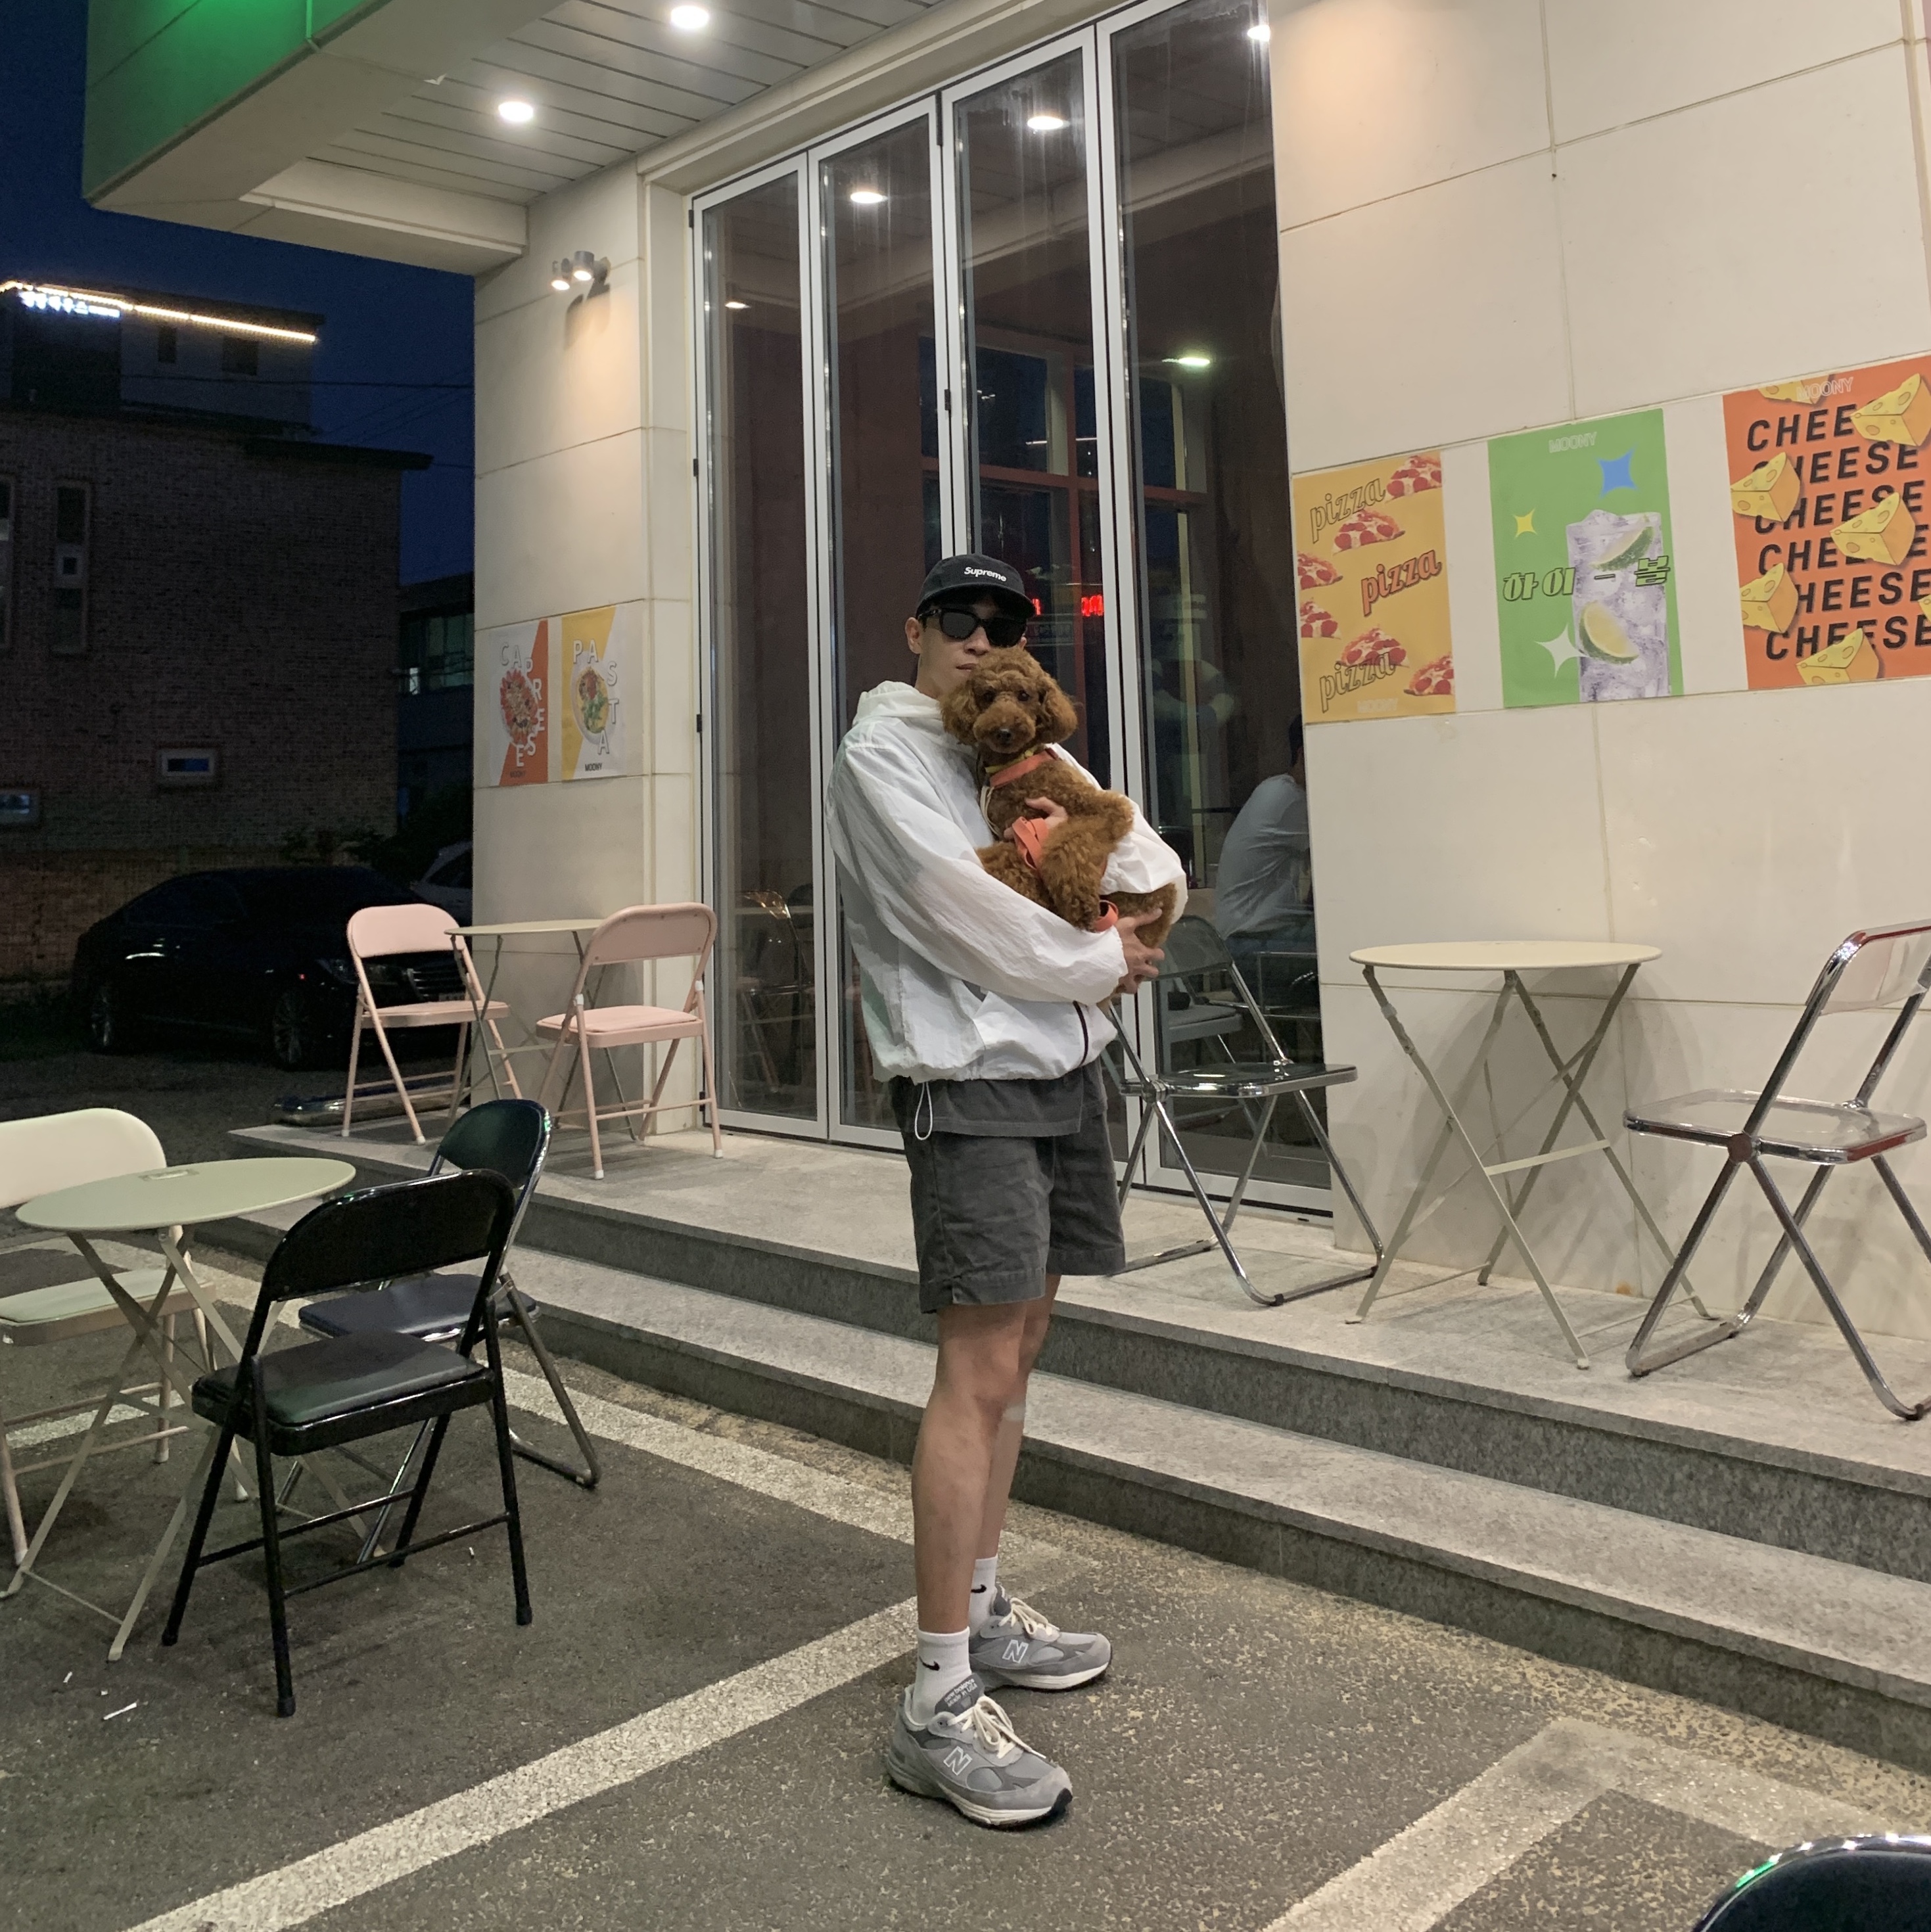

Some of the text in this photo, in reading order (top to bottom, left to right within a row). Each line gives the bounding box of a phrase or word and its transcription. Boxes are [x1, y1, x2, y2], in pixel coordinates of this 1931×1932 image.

[1796, 377, 1854, 401] MOONY
[1548, 431, 1598, 453] MOONY
[1746, 400, 1877, 452] CHEE
[1309, 478, 1386, 545] pizza
[964, 566, 1007, 582] Supreme
[1759, 524, 1930, 576] CHEE
[1360, 549, 1443, 618] pizza
[1794, 568, 1931, 615] HEESE
[572, 639, 620, 755] PASTA
[1319, 651, 1396, 714] pizza
[1001, 1639, 1029, 1664] N
[943, 1745, 973, 1776] N
